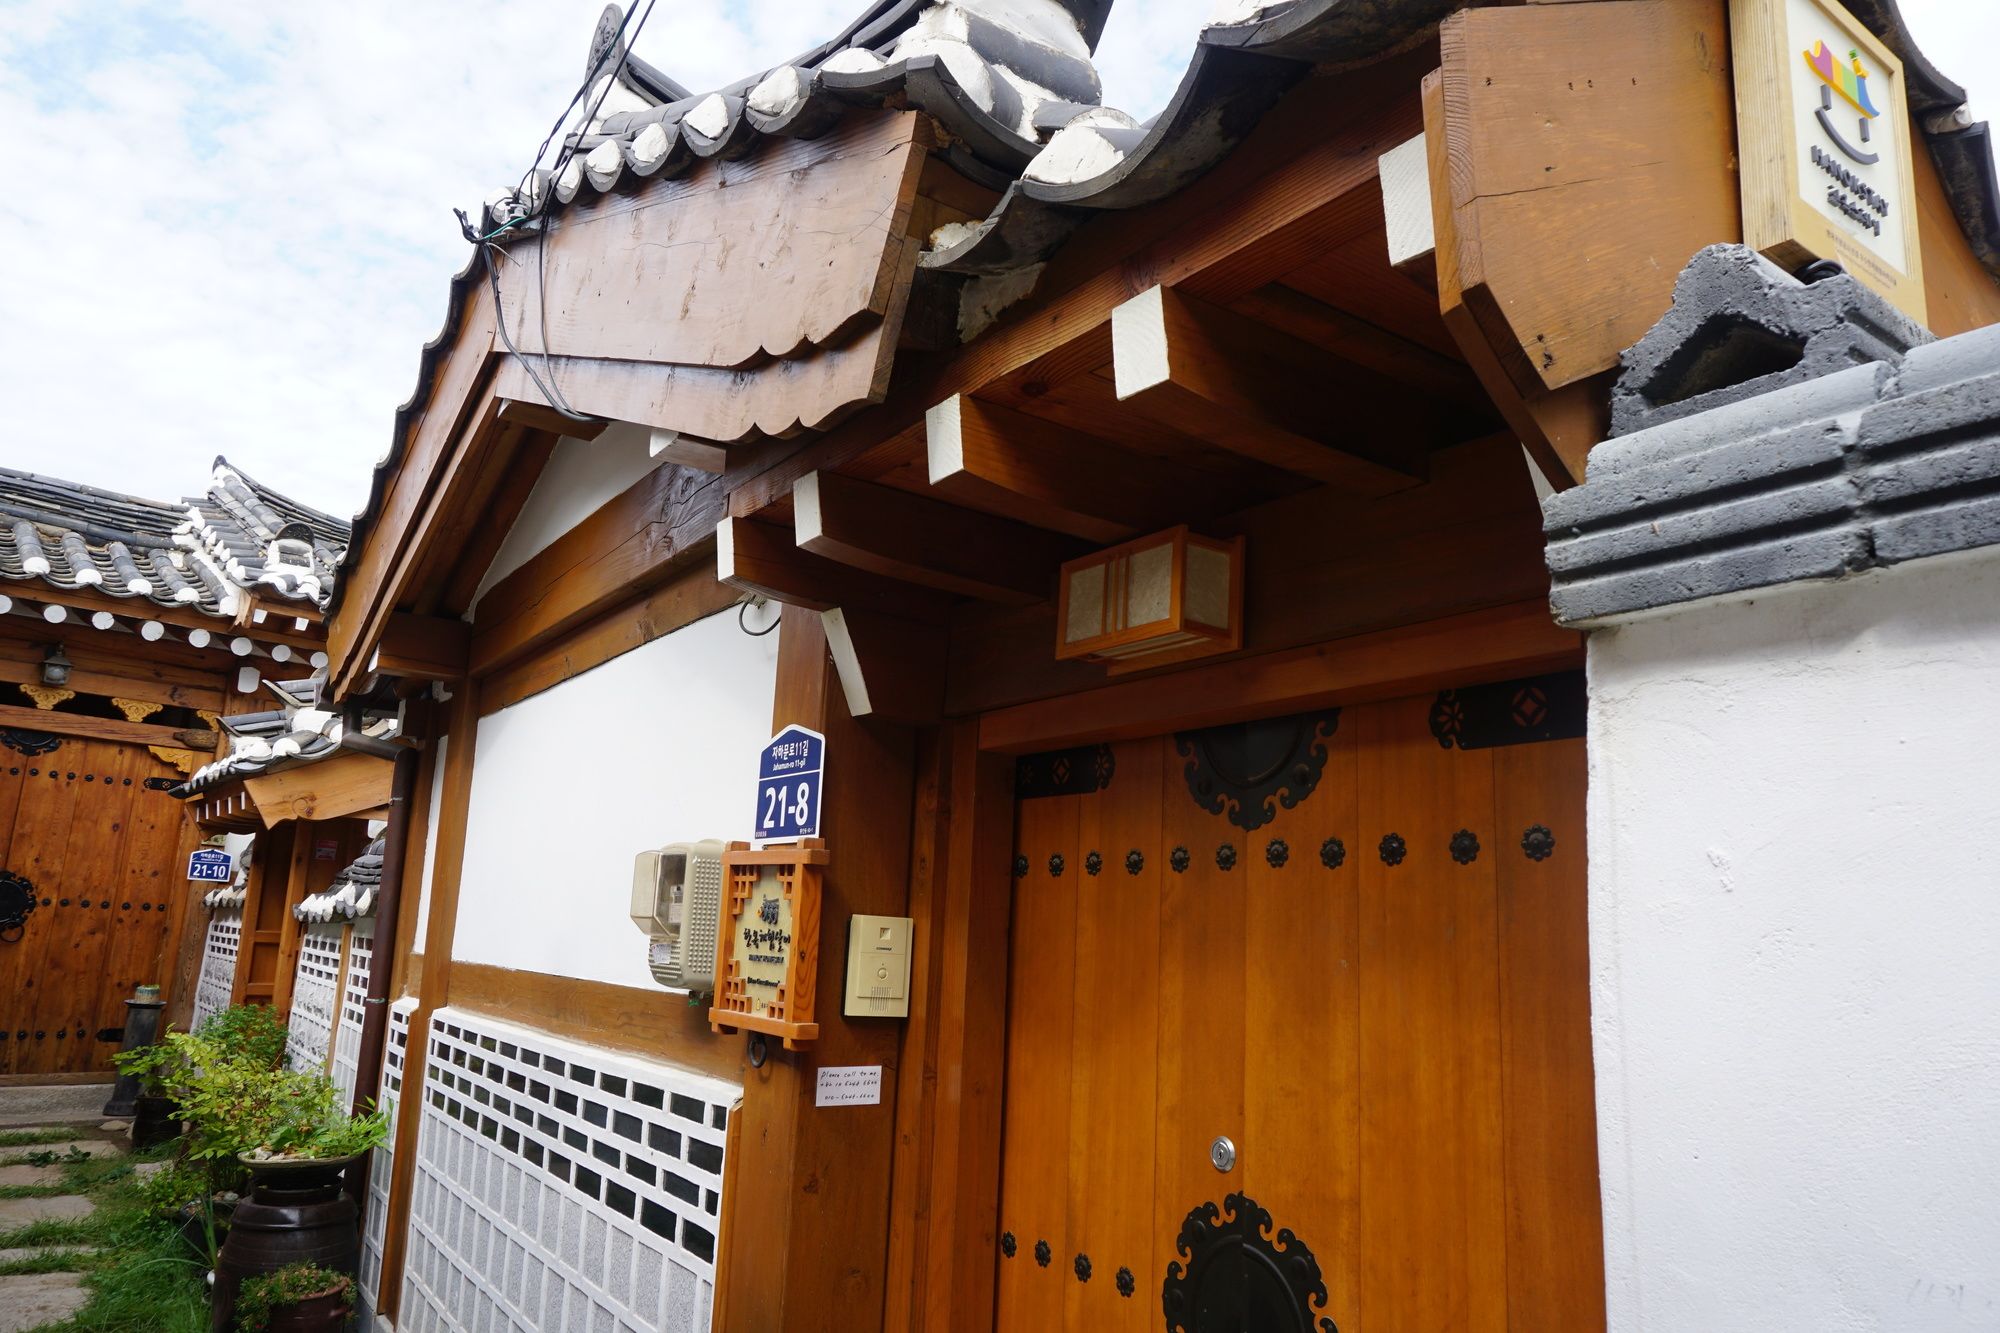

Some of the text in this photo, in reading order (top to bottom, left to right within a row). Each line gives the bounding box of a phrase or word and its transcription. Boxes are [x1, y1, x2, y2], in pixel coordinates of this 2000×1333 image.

[772, 740, 809, 760] 자하문로11길
[763, 782, 809, 829] 21-8
[192, 864, 226, 877] 21-10
